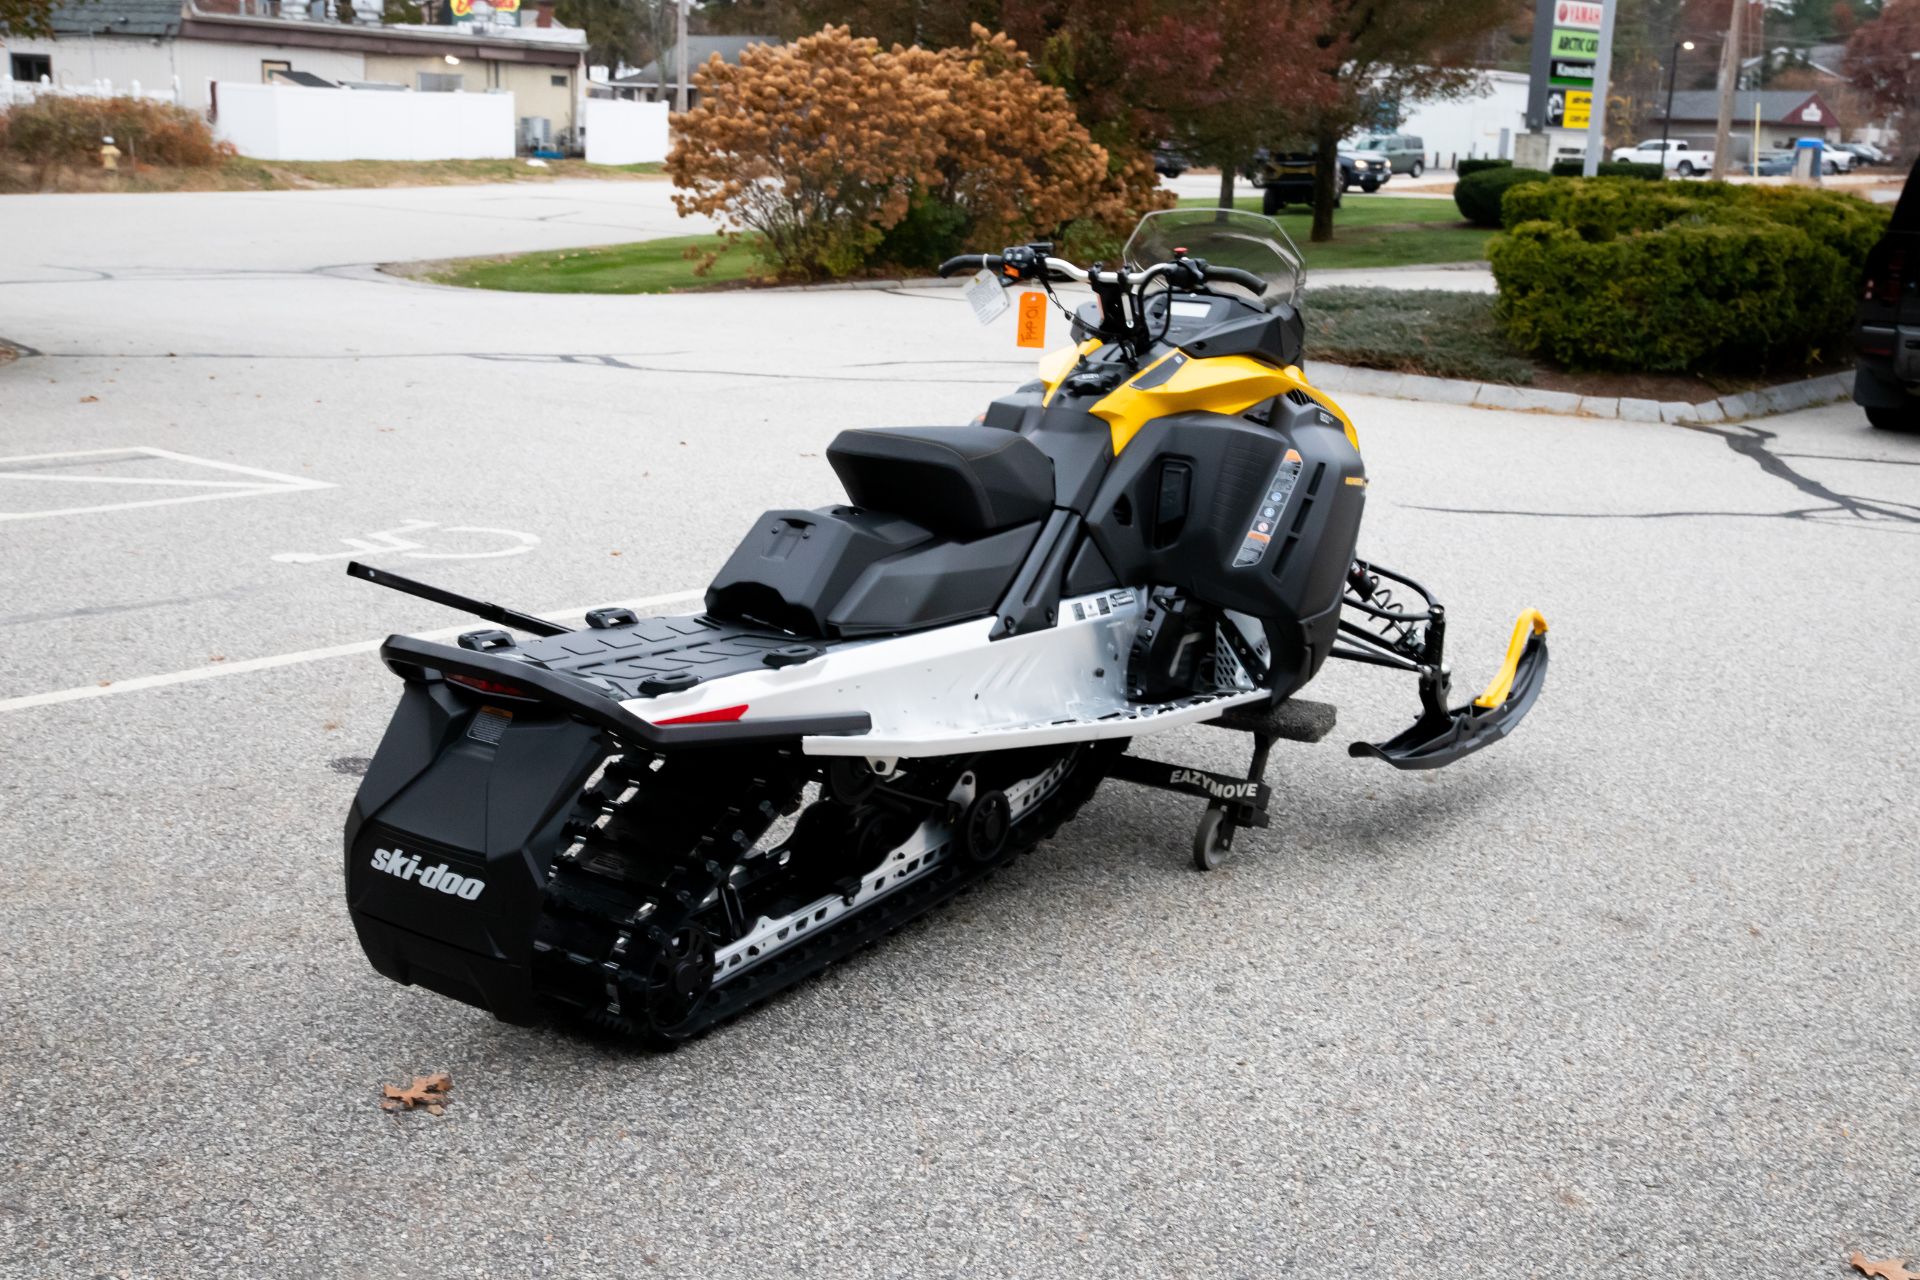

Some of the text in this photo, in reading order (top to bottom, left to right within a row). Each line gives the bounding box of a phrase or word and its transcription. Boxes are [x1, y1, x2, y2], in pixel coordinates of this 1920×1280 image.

[1569, 5, 1601, 24] YAMAH
[1558, 36, 1585, 51] ARCTIC
[1556, 63, 1593, 78] Kawasak
[370, 848, 486, 901] ski-doo
